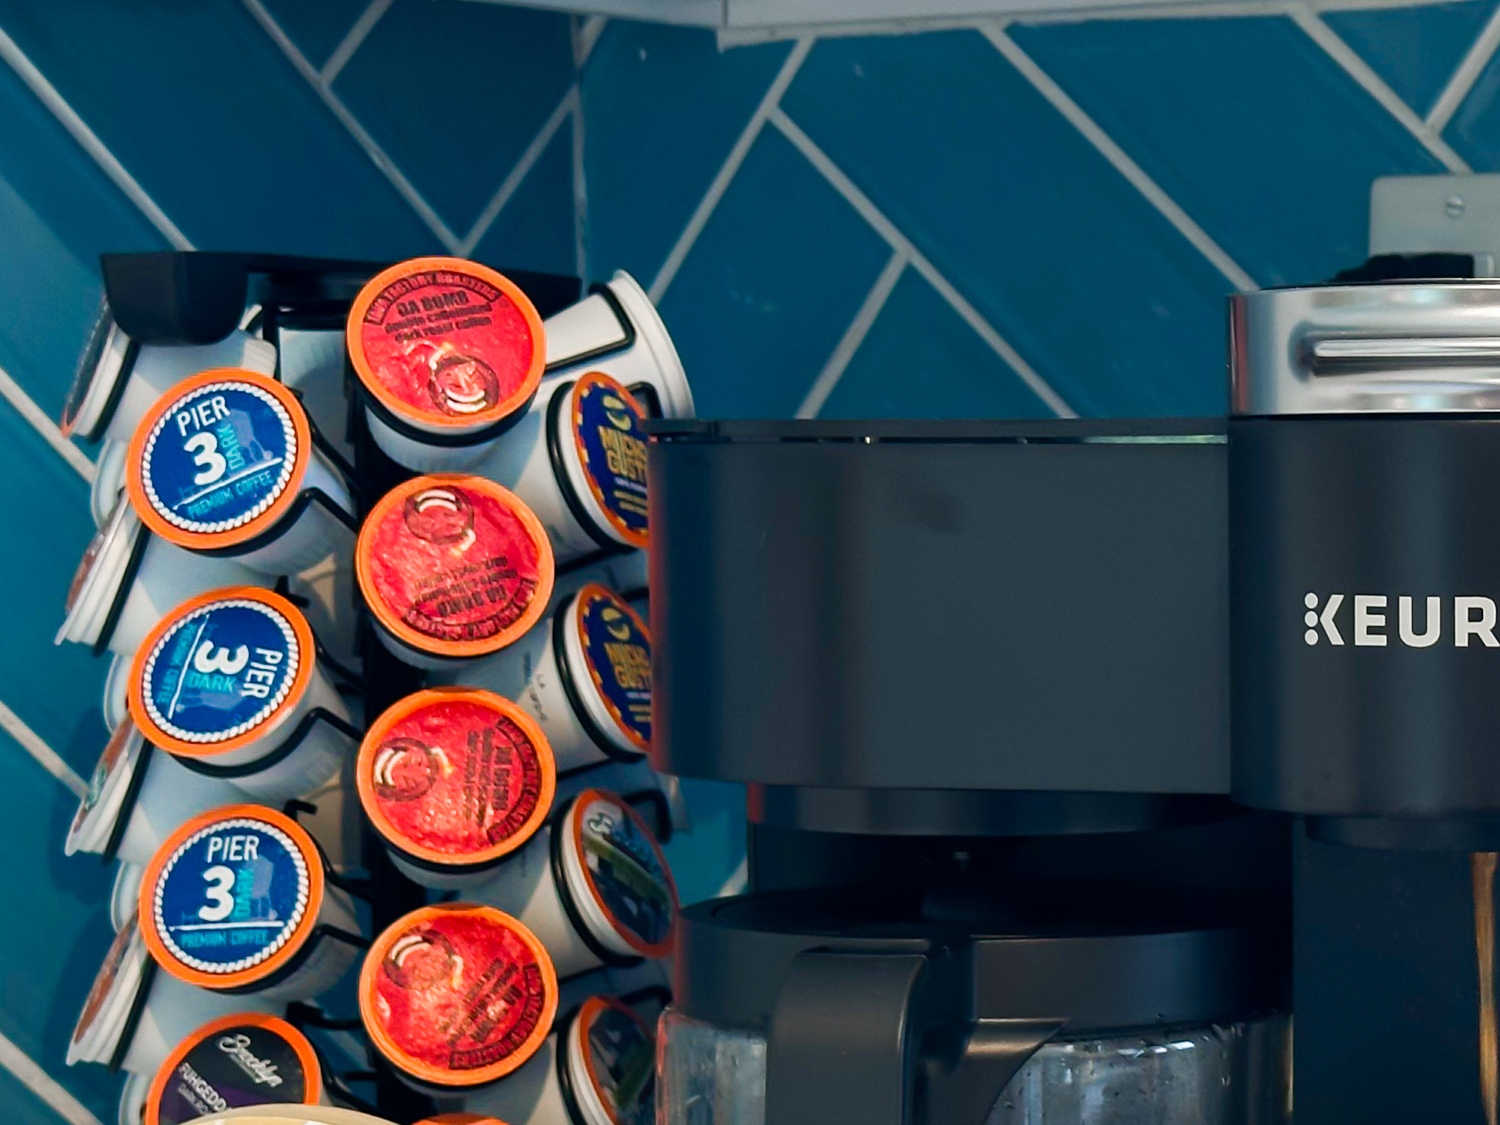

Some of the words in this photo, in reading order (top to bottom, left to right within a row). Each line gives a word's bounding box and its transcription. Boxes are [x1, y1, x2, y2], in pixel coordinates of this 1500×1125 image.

[176, 395, 231, 437] PIER
[184, 431, 227, 486] 3
[218, 422, 246, 470] DARK
[187, 486, 234, 519] PREMIUM
[235, 470, 274, 497] COFFEE
[194, 639, 250, 675] 3
[239, 647, 284, 699] PIER
[188, 672, 237, 693] DARK
[207, 835, 260, 864] PIER
[198, 864, 236, 922] 3
[178, 1062, 231, 1113] FUHGEDD
